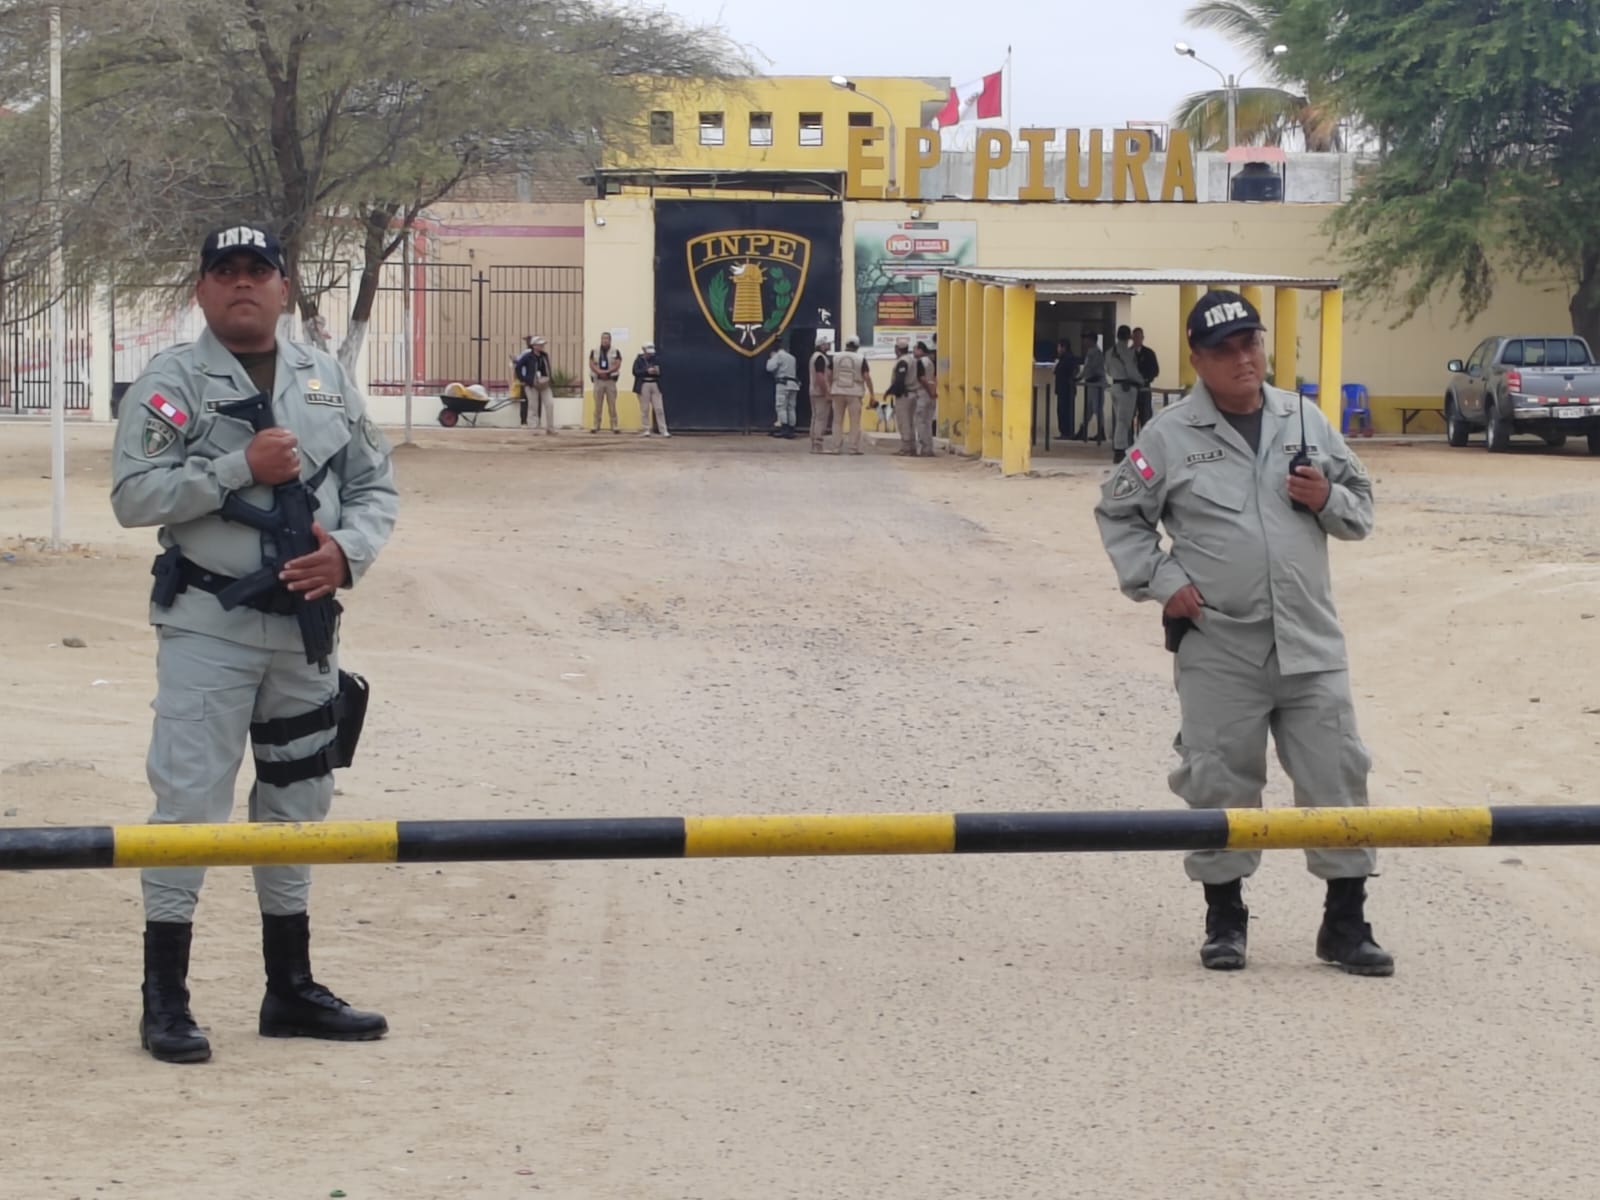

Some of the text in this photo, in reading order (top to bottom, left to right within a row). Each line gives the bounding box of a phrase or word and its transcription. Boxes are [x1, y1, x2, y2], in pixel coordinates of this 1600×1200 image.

[972, 127, 1198, 201] PIURA
[217, 226, 267, 249] INPE
[702, 234, 797, 262] INPE
[1204, 301, 1248, 328] INPE
